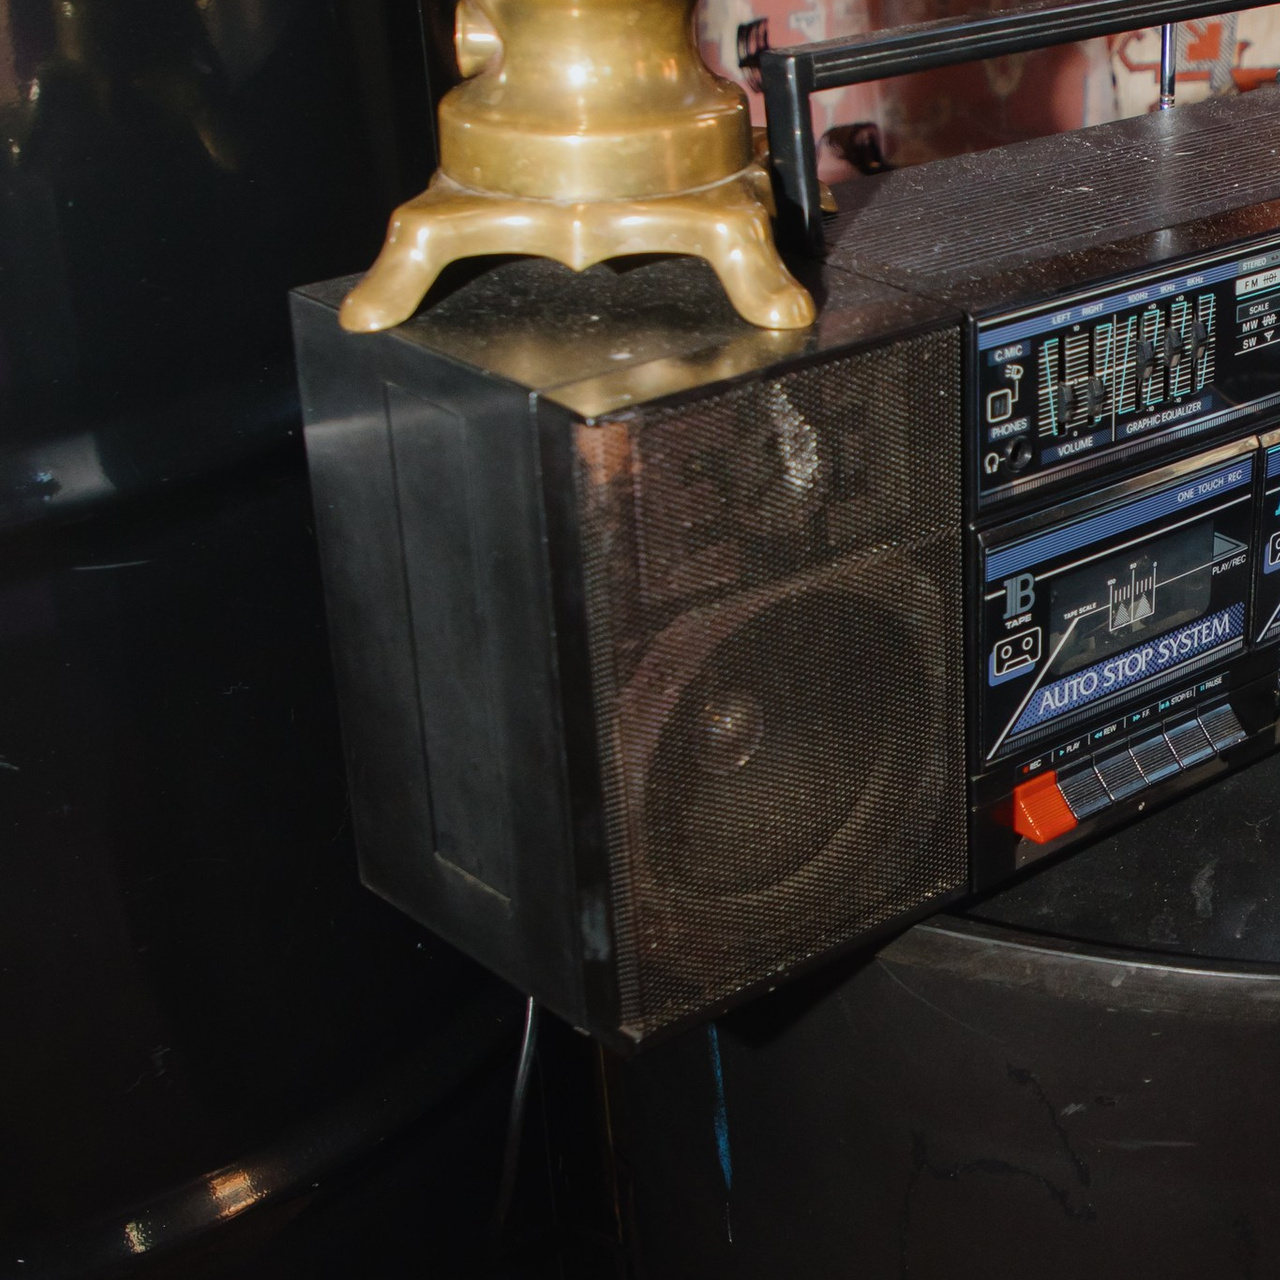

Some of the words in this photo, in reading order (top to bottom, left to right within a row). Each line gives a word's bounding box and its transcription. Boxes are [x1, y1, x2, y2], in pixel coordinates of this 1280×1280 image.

[1242, 257, 1267, 271] STEREO
[1128, 292, 1148, 303] 100Hz
[1052, 312, 1071, 325] LEFT
[1082, 303, 1103, 316] RIGHT
[1249, 302, 1270, 315] SCALE
[1073, 324, 1080, 332] 10
[1242, 320, 1259, 333] MW
[1242, 337, 1257, 349] SW
[1126, 414, 1161, 434] GRAPHIC
[1161, 401, 1202, 422] EQUALIZER
[991, 418, 1027, 438] PHONES
[1058, 436, 1093, 456] VOLUME
[1177, 488, 1195, 502] ONE
[1198, 477, 1224, 494] TOUCH
[1228, 469, 1243, 483] REC
[1212, 554, 1247, 576] PLAY/REC
[1003, 572, 1036, 620] B
[1063, 609, 1078, 620] TAPE
[1078, 602, 1097, 614] SCALE
[1004, 613, 1032, 630] TAPE
[1038, 672, 1098, 715] AUTO
[1103, 648, 1153, 687] STOP
[1158, 614, 1230, 663] SYSTEM
[1029, 759, 1042, 771] REC
[1066, 741, 1080, 753] PLAY
[1103, 724, 1117, 736] REW
[1206, 676, 1222, 689] PAUSE
